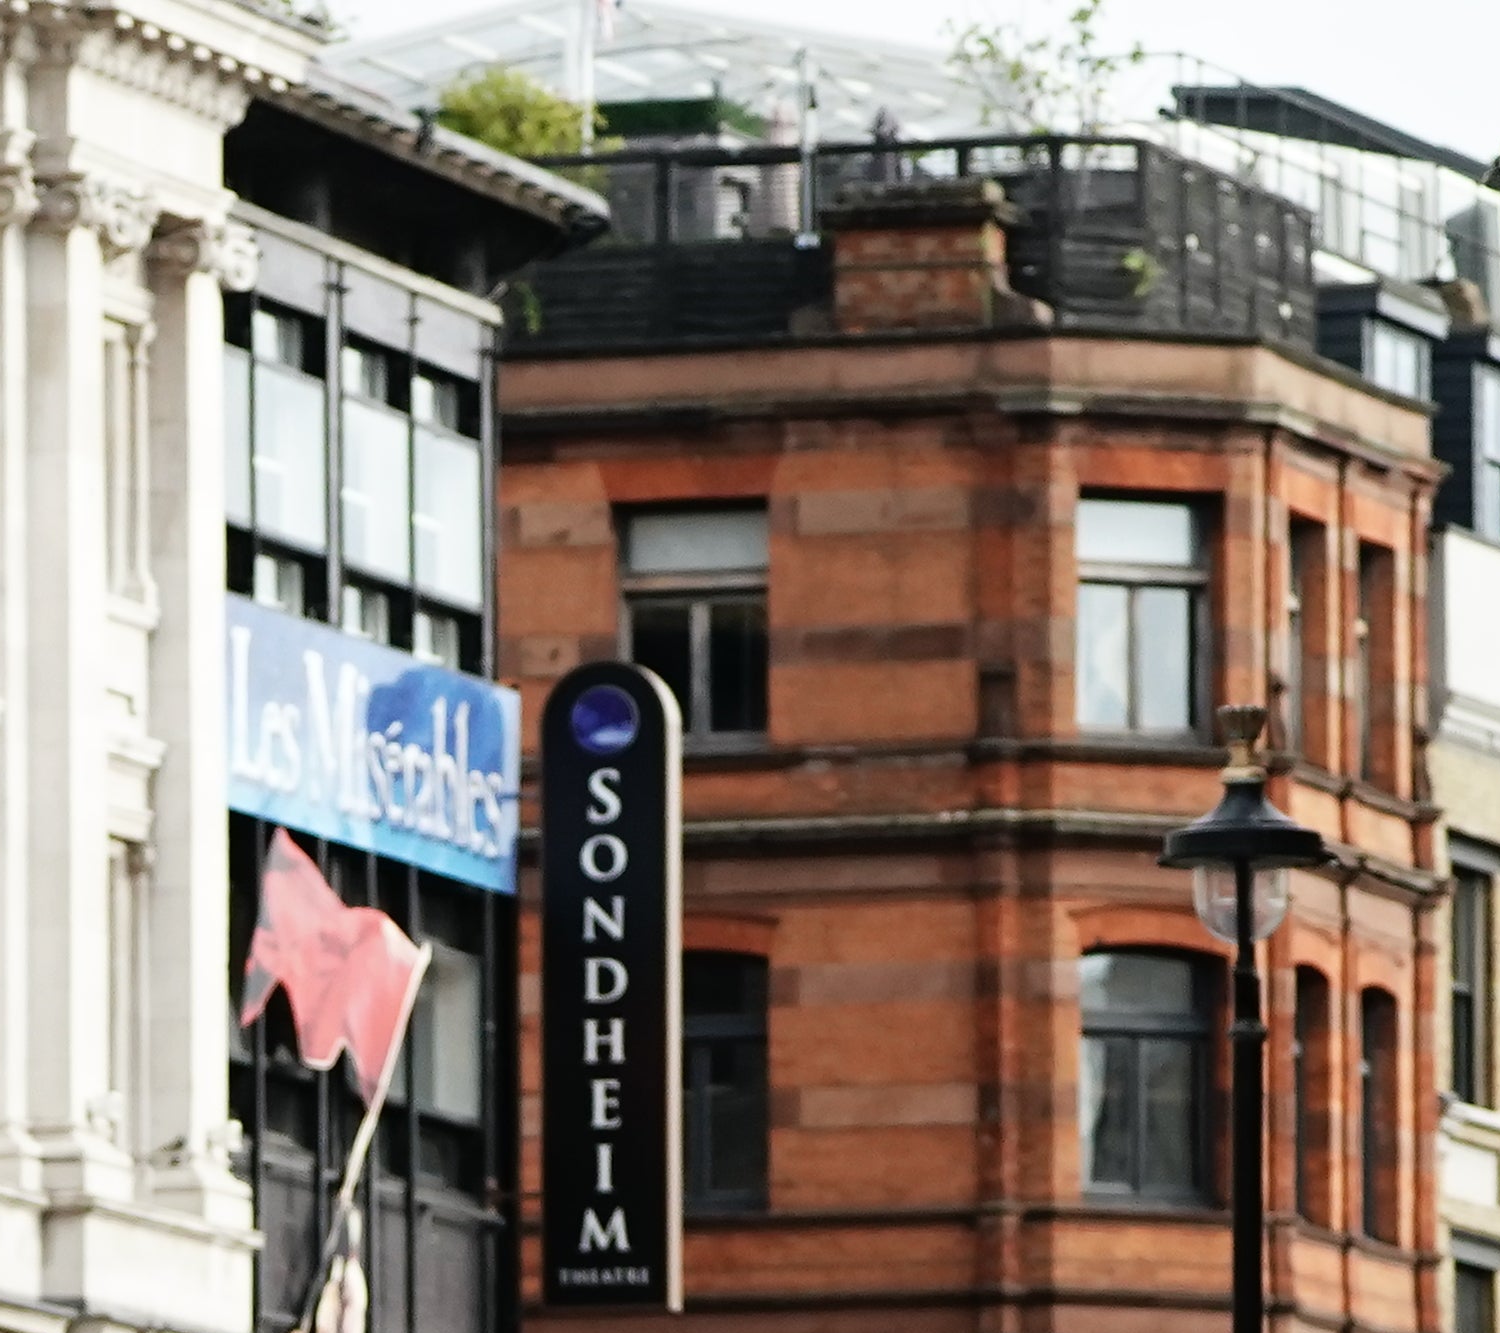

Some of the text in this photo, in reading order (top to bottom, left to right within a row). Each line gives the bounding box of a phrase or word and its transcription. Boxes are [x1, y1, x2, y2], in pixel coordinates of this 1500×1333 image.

[229, 623, 506, 862] Les Misérables
[578, 766, 631, 1252] SONDHEIM
